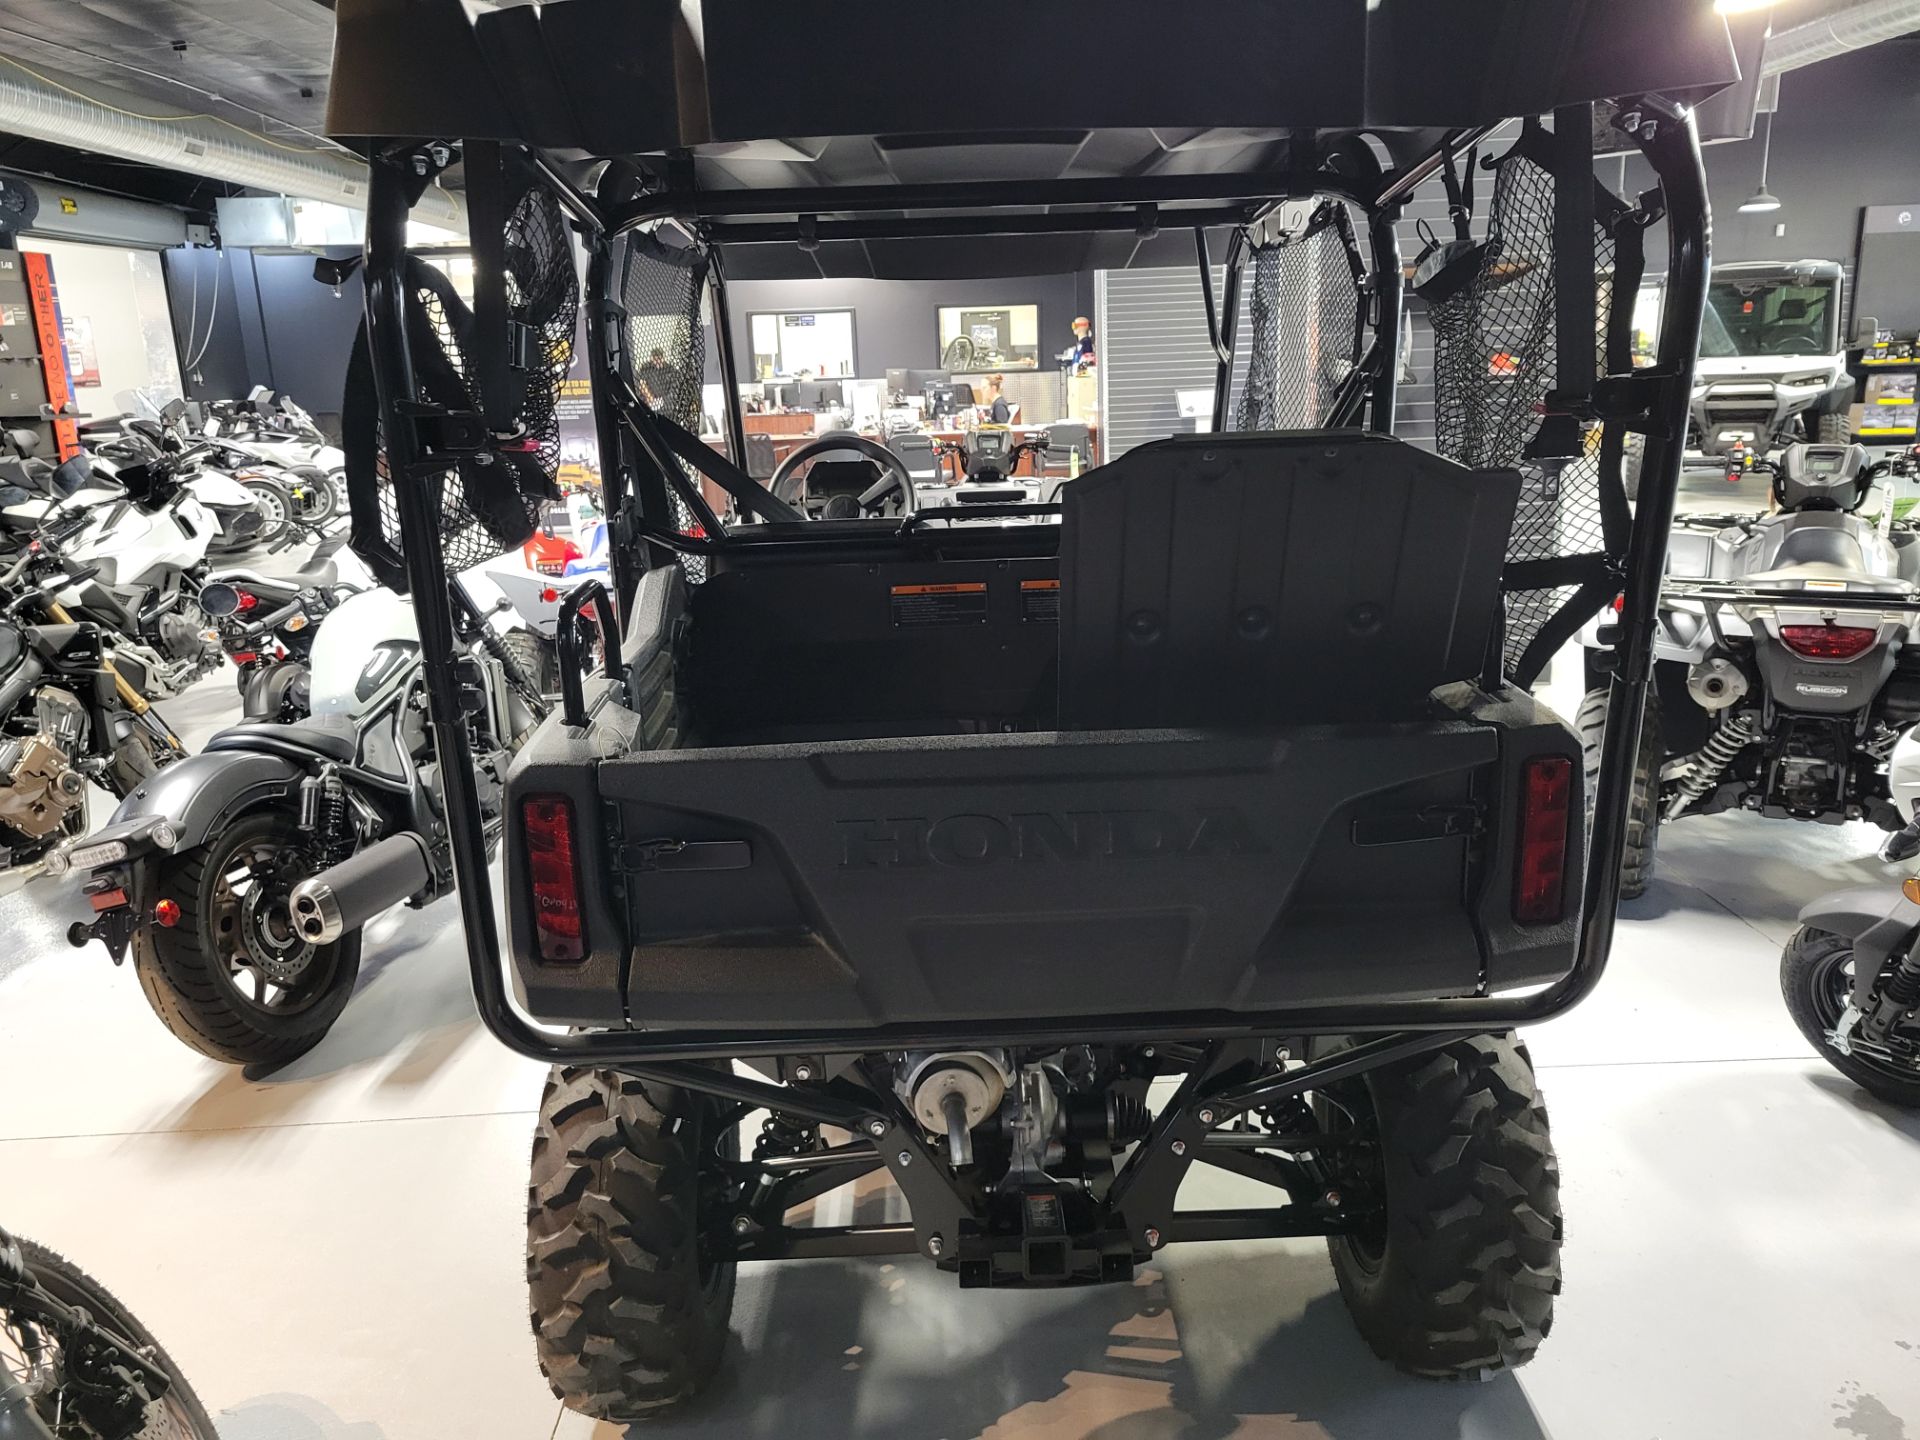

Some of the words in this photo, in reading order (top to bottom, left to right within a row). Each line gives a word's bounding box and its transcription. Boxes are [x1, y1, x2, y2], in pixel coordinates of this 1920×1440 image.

[34, 273, 56, 347] OTHER
[1796, 685, 1848, 694] RUBICON
[833, 807, 1272, 869] HONDA
